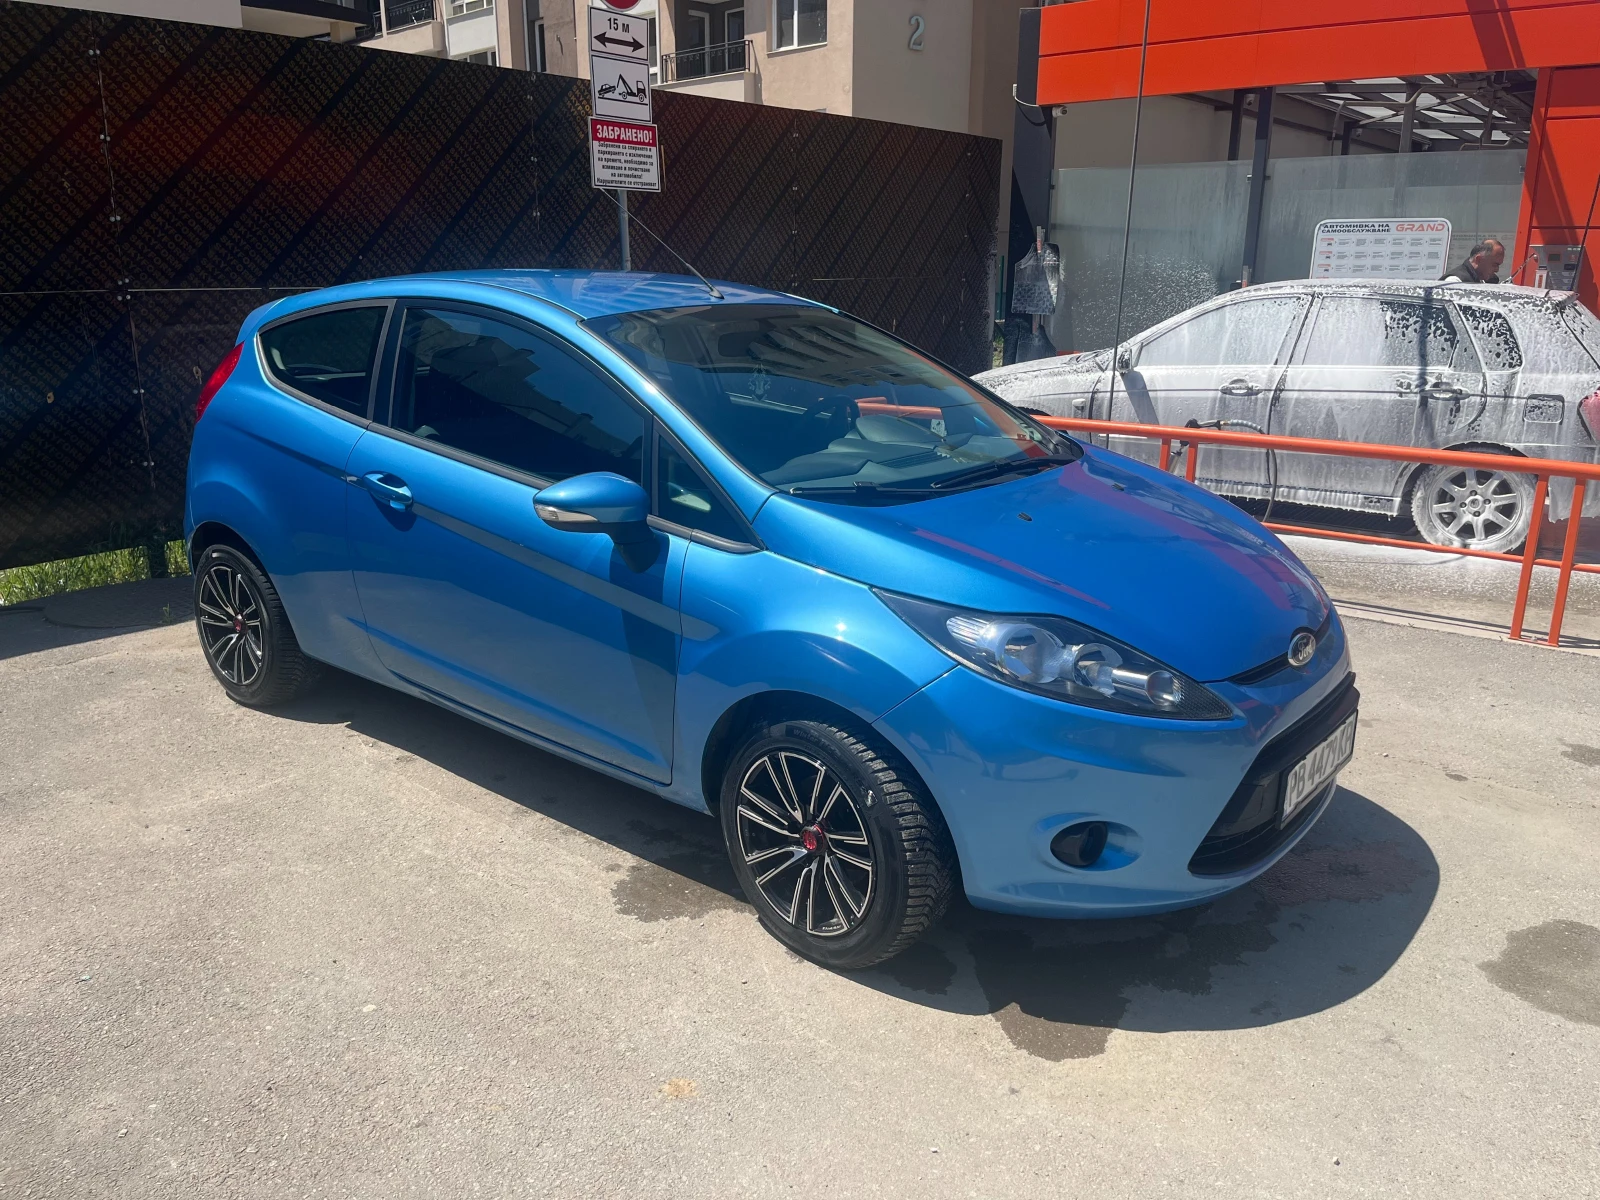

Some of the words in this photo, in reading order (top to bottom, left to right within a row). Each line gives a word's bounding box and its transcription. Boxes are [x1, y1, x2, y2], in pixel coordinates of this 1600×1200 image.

[607, 17, 618, 31] 15
[909, 15, 925, 50] 2
[596, 124, 652, 143] ЗАБРАНЕНО!
[1396, 223, 1445, 232] GRAND
[1298, 638, 1312, 660] Ford
[1308, 736, 1338, 786] 4479
